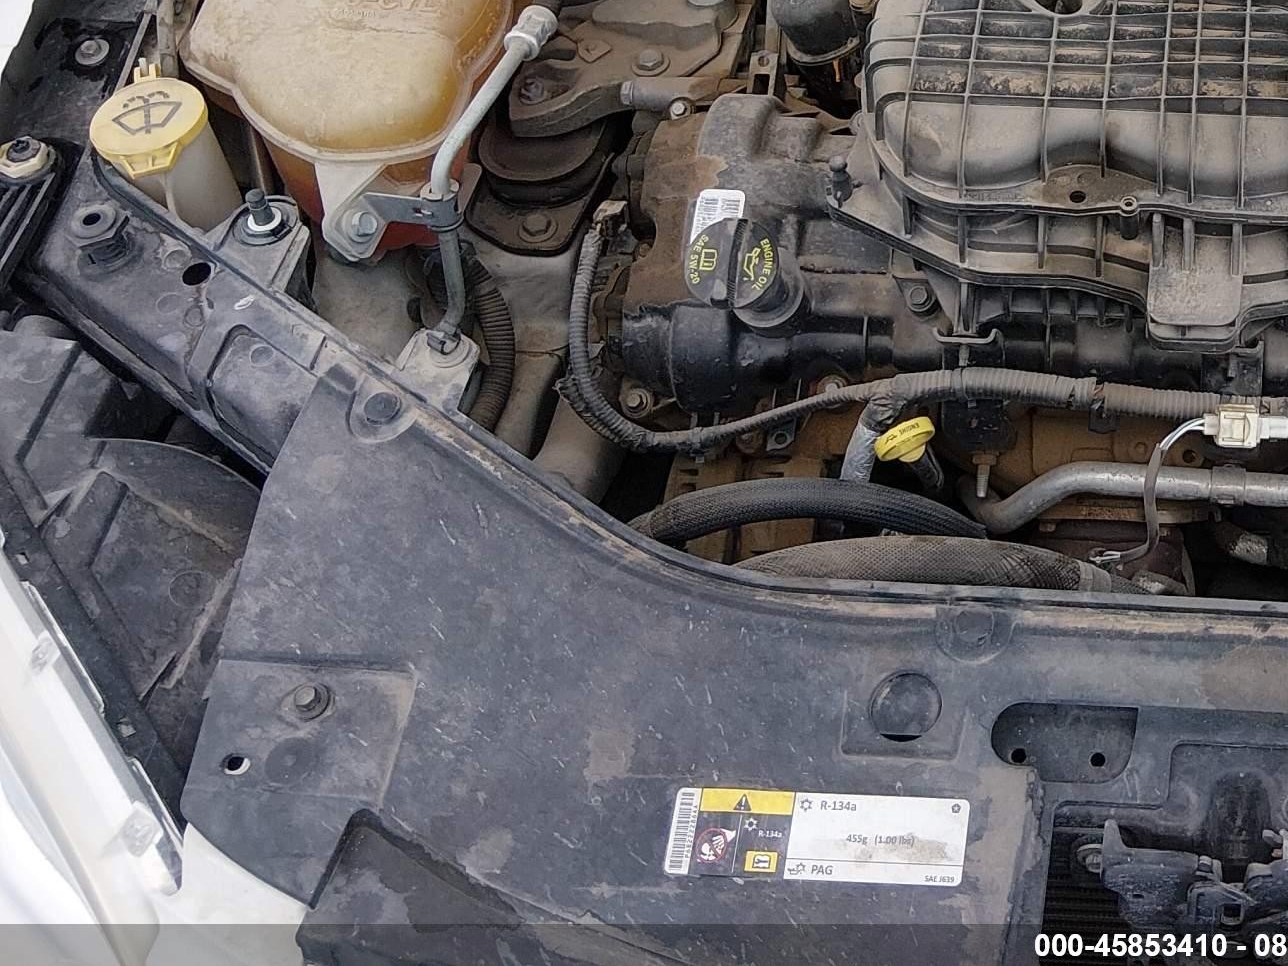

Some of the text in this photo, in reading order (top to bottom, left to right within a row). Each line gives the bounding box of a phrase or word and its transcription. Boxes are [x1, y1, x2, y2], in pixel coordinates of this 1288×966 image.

[688, 234, 709, 285] SAE 5W-20
[751, 238, 775, 290] ENGINE OIL
[820, 800, 857, 812] R-134a
[758, 830, 783, 838] R-134a
[846, 835, 915, 847] 455g (1.00 lbs)
[811, 865, 833, 875] PAG
